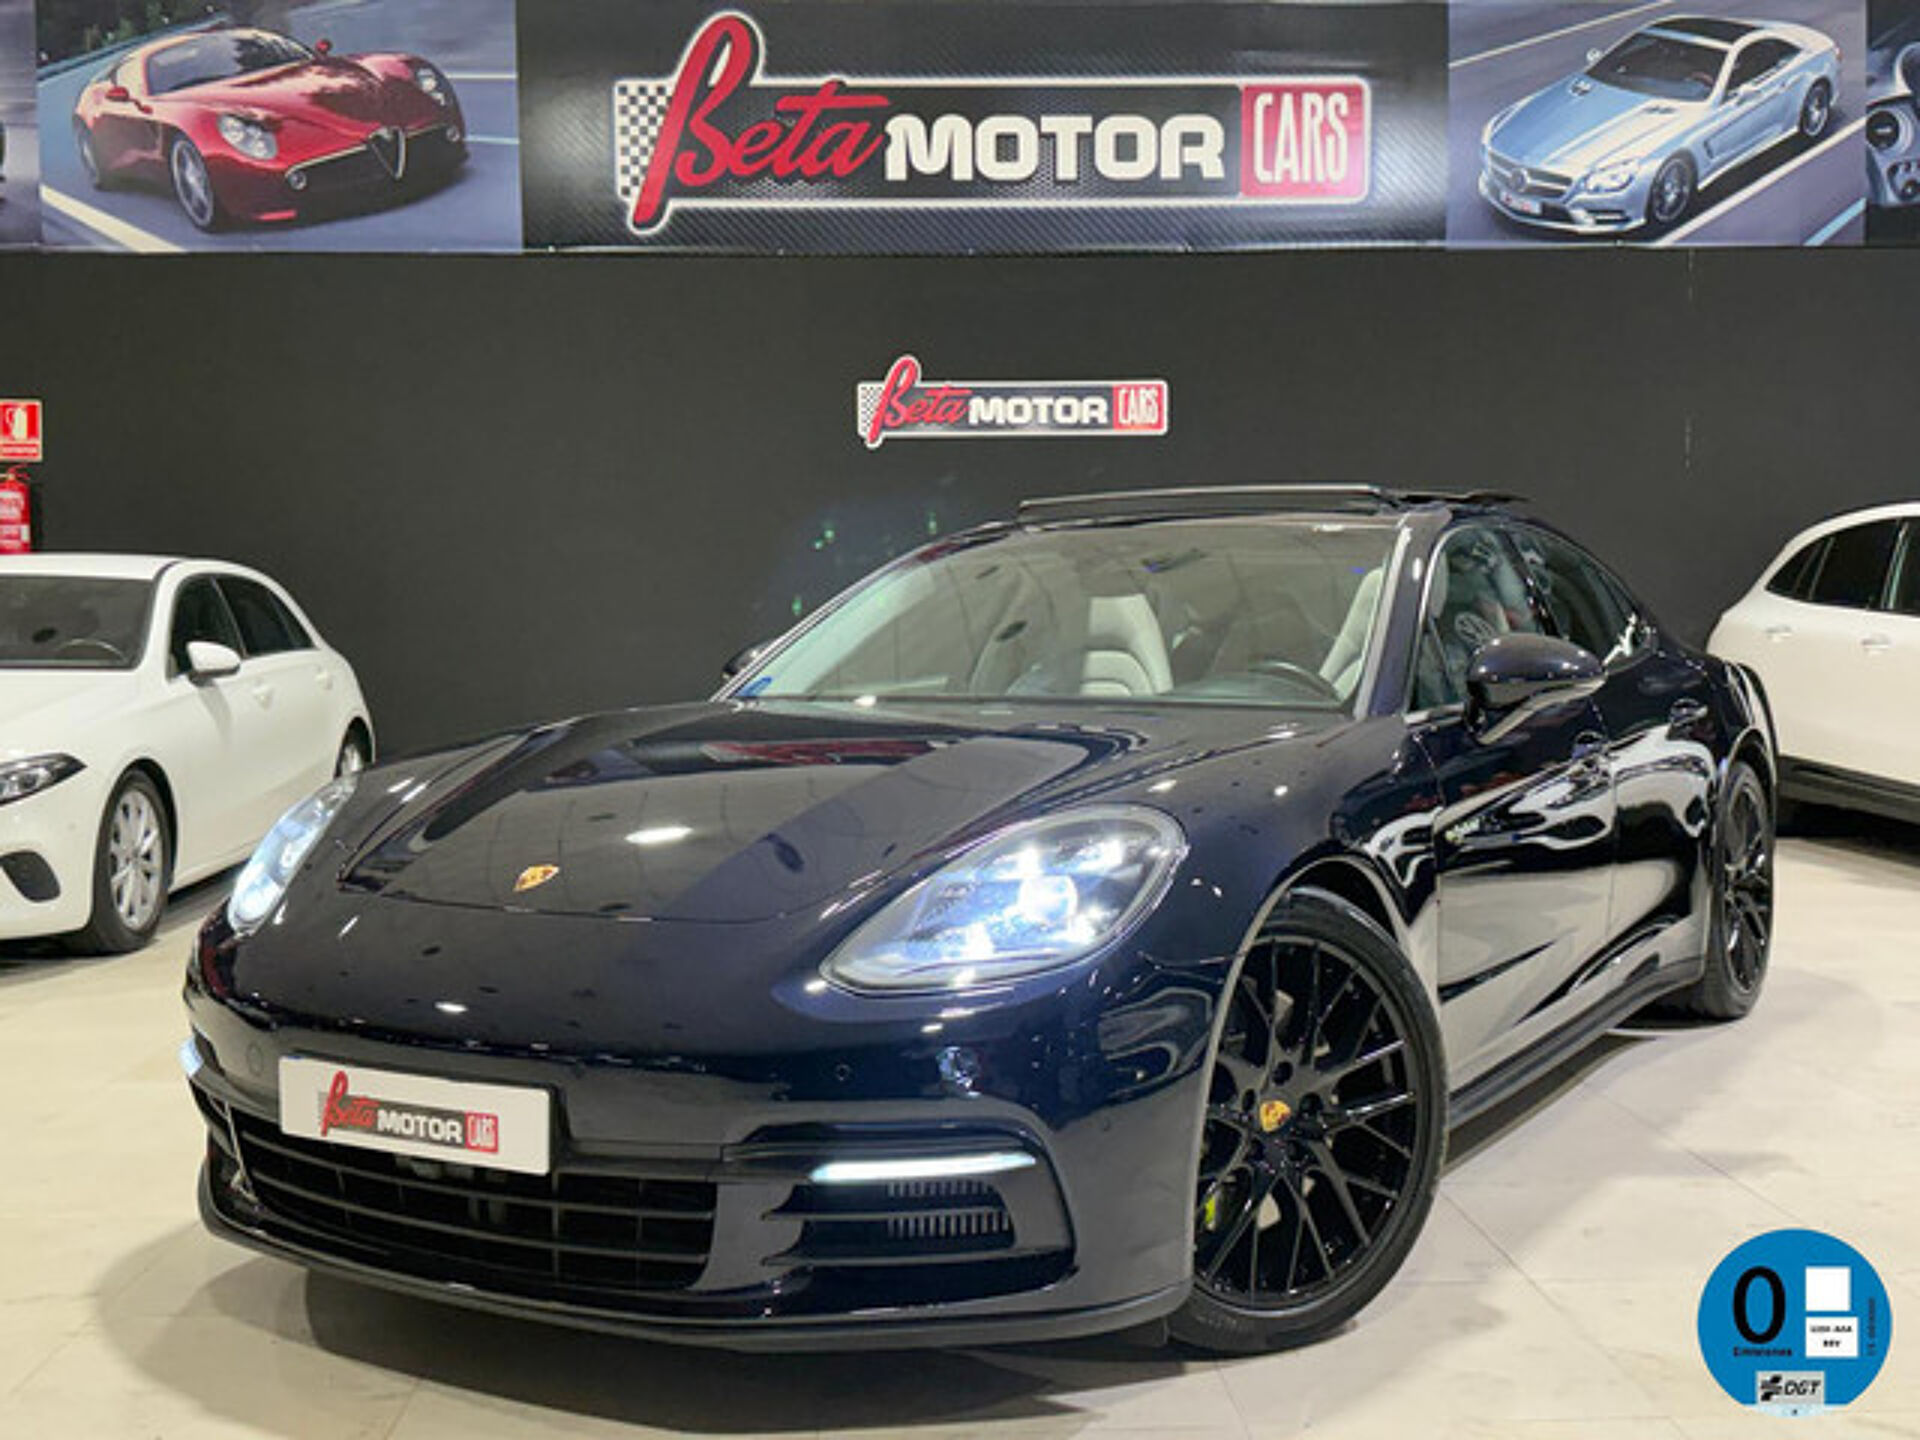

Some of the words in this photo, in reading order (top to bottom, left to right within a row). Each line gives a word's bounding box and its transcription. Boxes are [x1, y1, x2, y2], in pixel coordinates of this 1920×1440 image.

[885, 113, 1225, 182] MOTOR
[1253, 92, 1350, 185] CARS
[968, 395, 1108, 425] MOTOR
[1117, 386, 1160, 425] CARS
[377, 1109, 463, 1143] MOTOR
